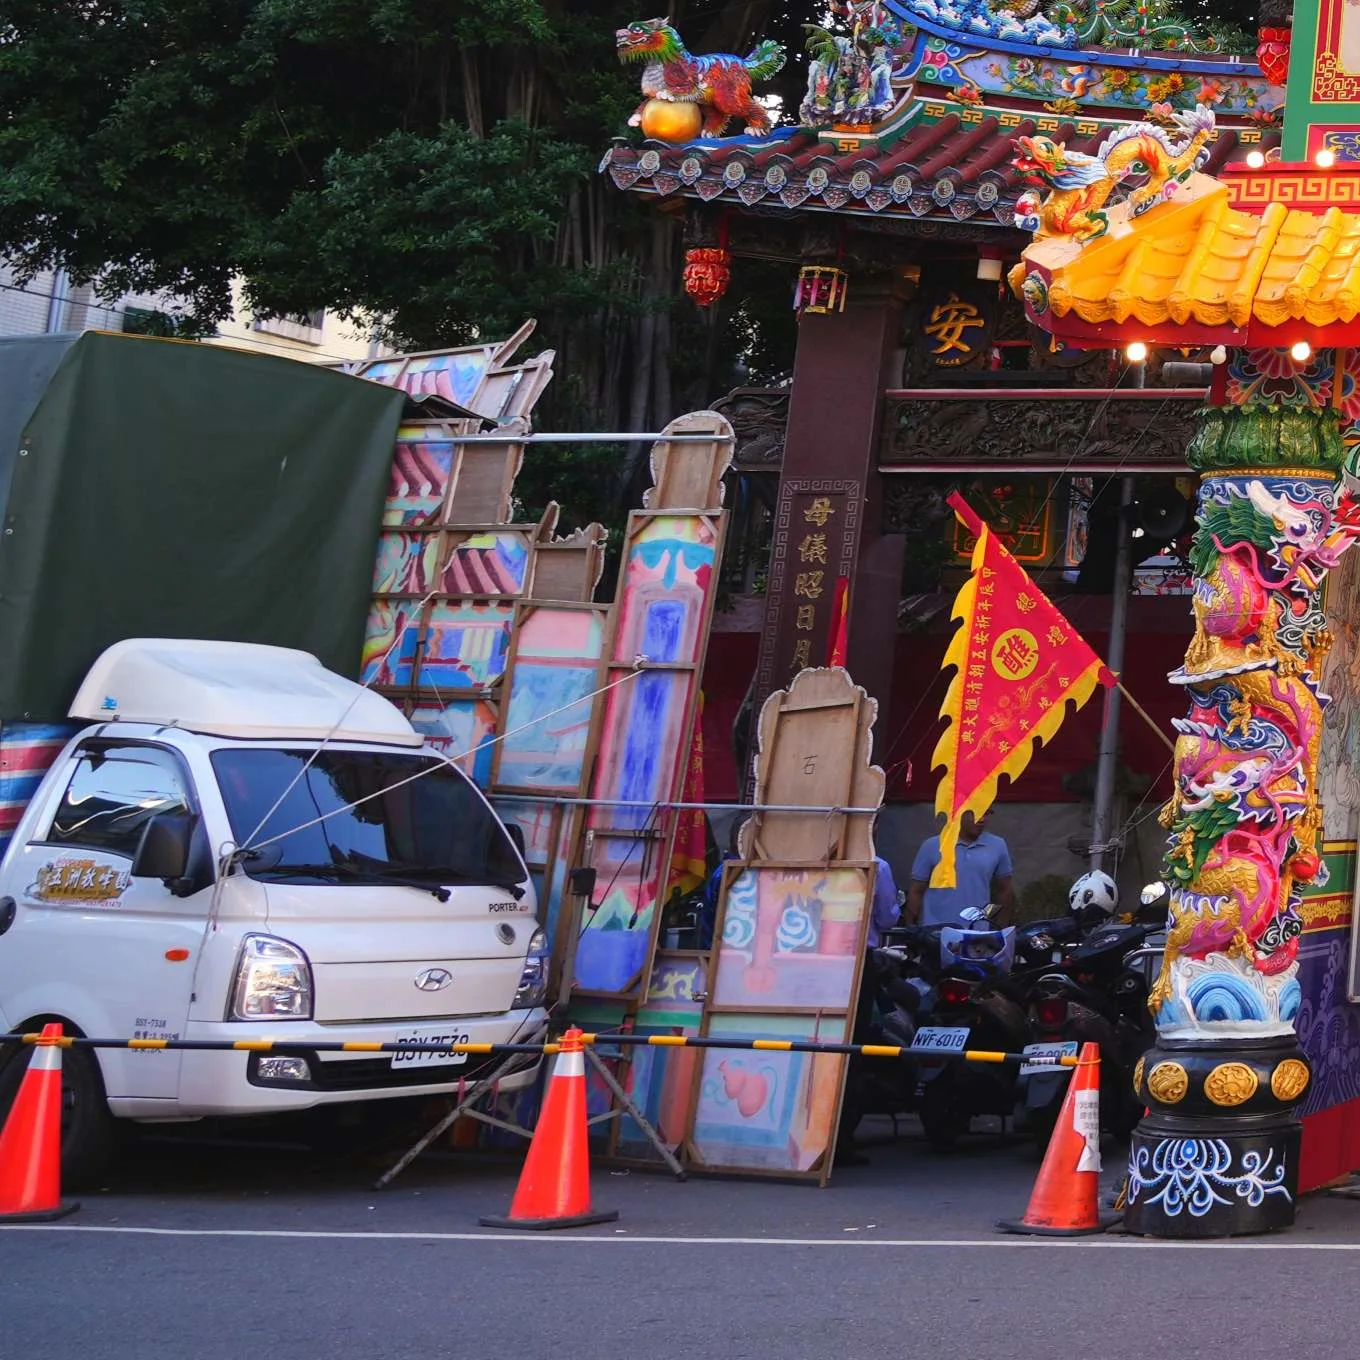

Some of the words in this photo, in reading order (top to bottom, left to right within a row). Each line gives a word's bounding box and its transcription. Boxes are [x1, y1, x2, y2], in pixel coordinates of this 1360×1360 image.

[923, 296, 986, 357] 安
[1015, 590, 1068, 648] 總壇
[801, 754, 819, 776] 石
[488, 902, 518, 913] PORTER
